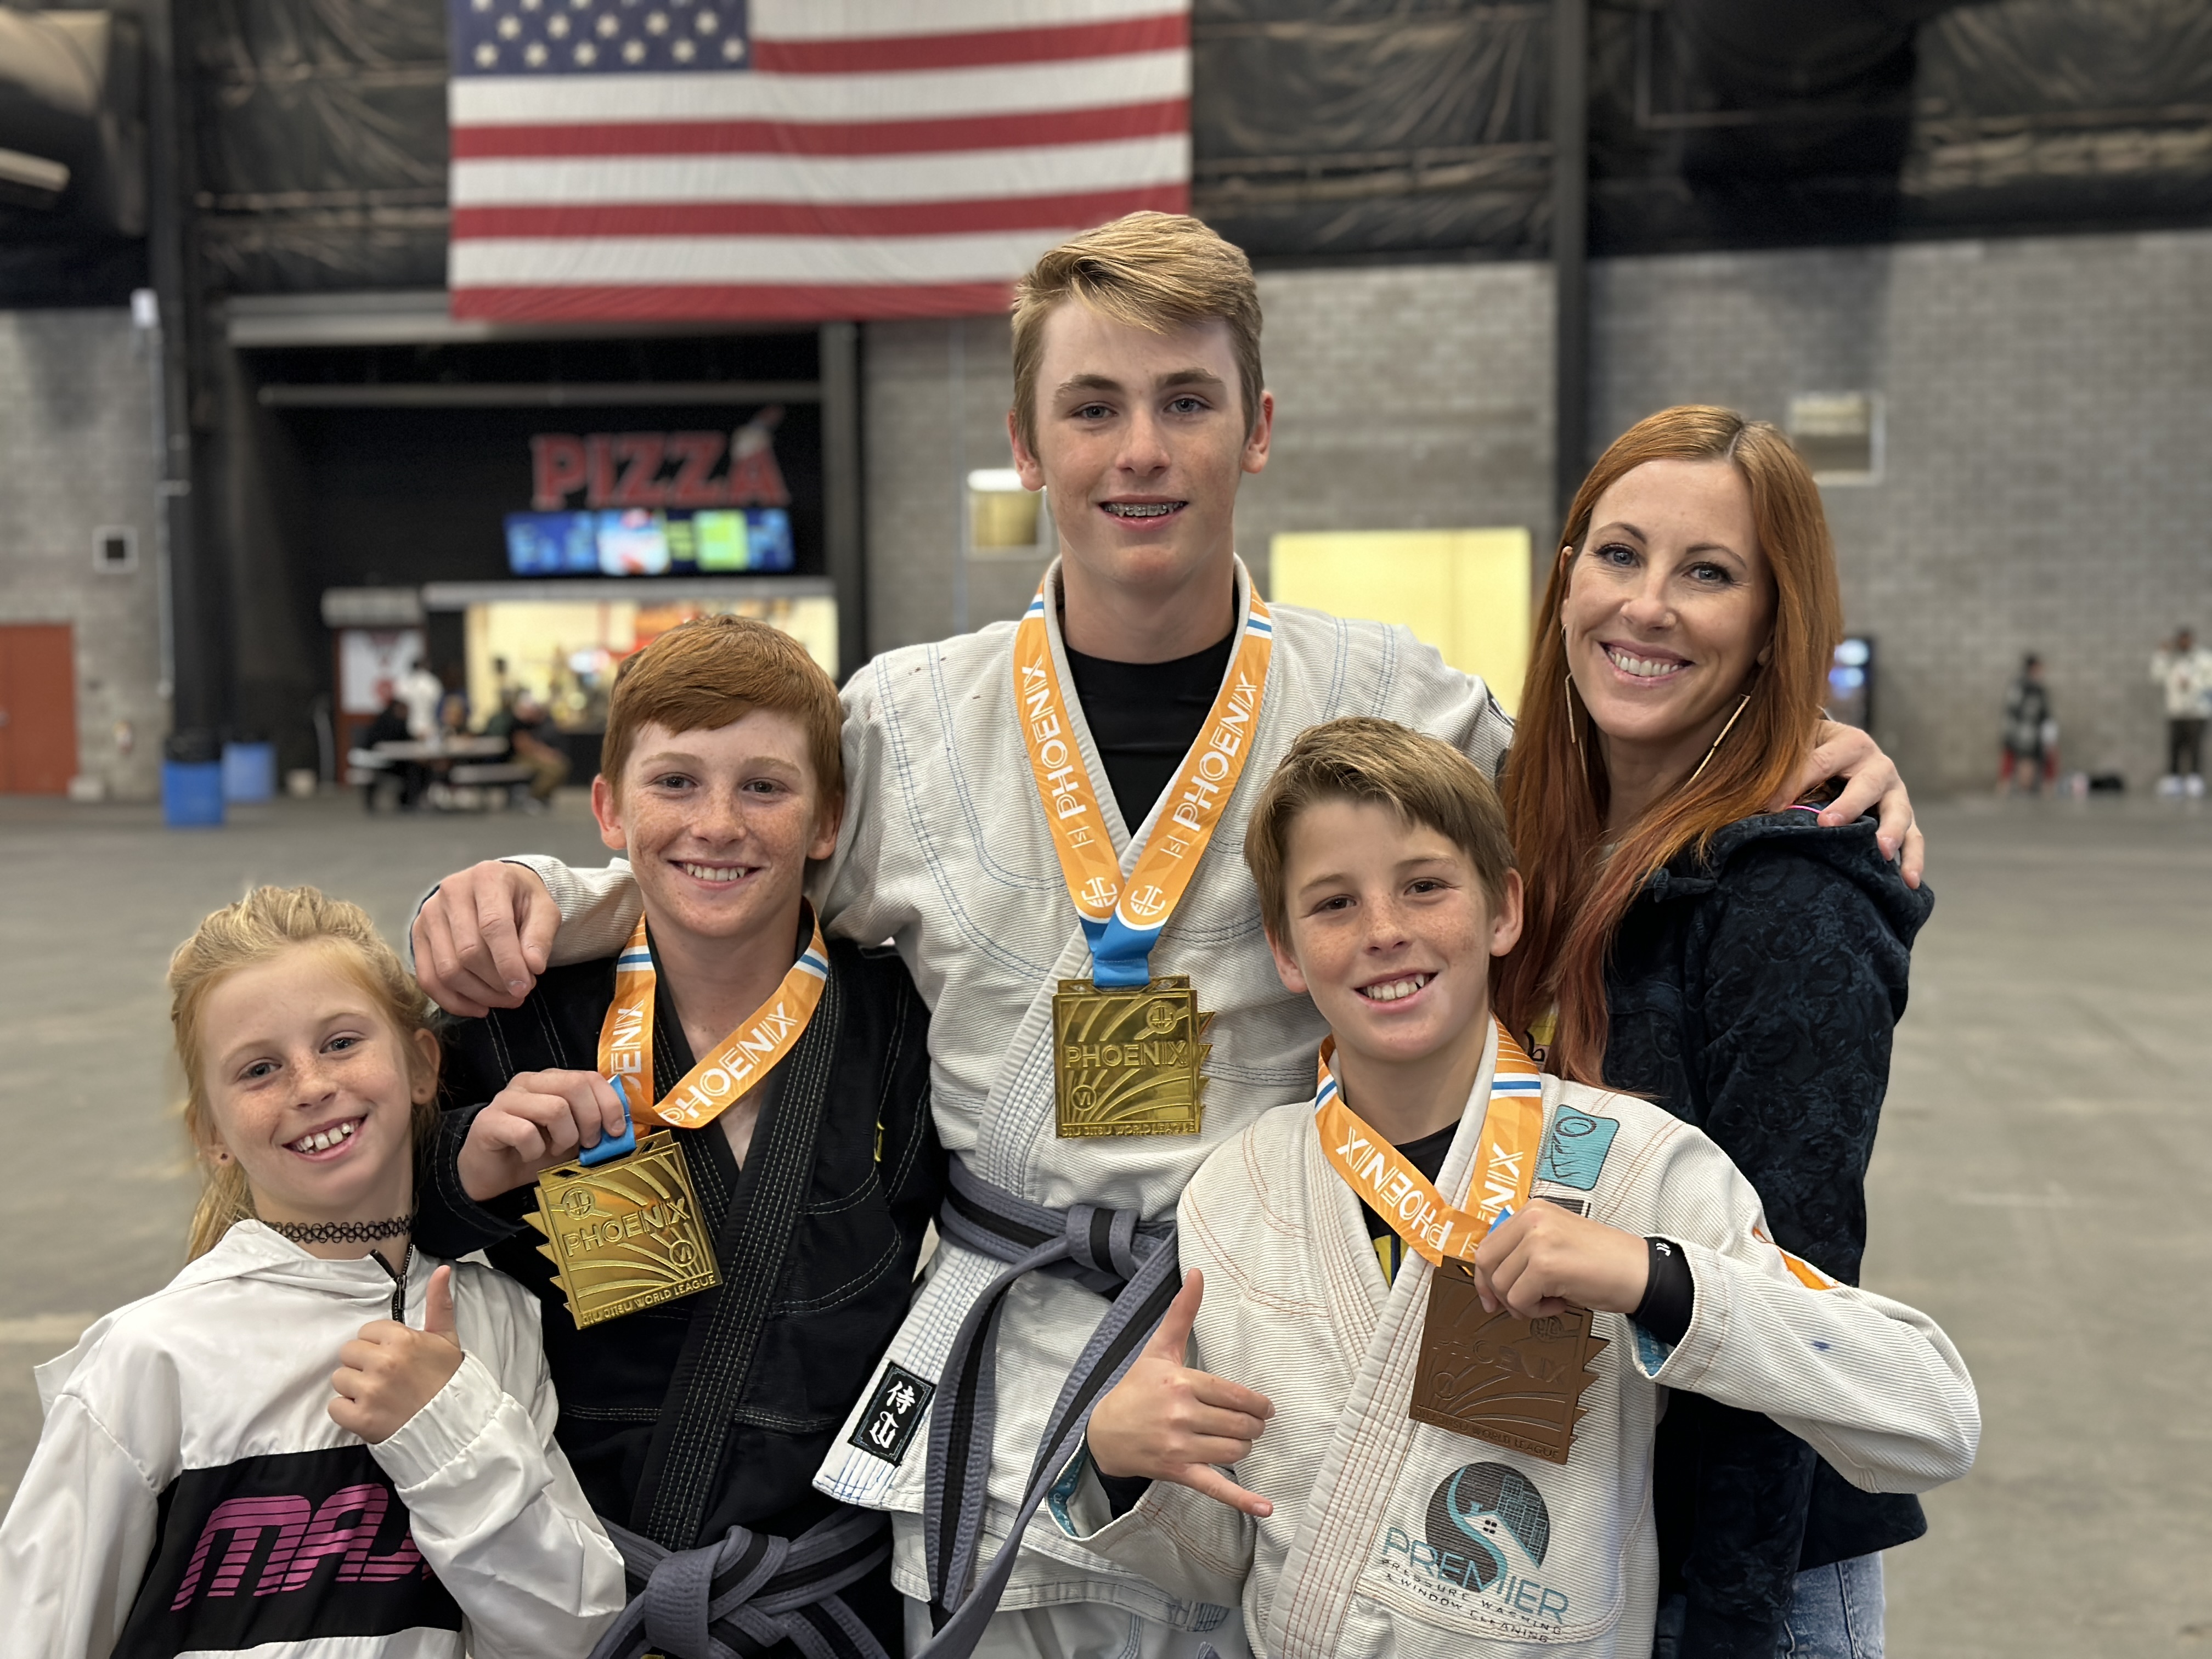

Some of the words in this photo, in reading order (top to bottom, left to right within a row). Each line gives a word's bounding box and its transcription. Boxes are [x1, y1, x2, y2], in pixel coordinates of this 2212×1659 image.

[531, 430, 791, 510] PIZZA
[1022, 654, 1086, 820] PHOENIX
[1172, 671, 1257, 831] PHOENIX
[658, 1001, 798, 1124] PHOENIX
[1064, 1040, 1189, 1068] PHOENIX
[1116, 1125, 1151, 1136] WORLD
[1154, 1123, 1195, 1134] LEAGUE
[562, 1198, 691, 1256] PHOENIX
[1336, 1126, 1454, 1252] PHOENIX
[603, 1302, 631, 1318] JITSU
[634, 1289, 672, 1307] WORLD
[674, 1274, 716, 1296] LEAGUE
[1472, 1425, 1511, 1446] WORLD
[1514, 1438, 1559, 1459] LEAGUE
[1381, 1527, 1569, 1624] PREMIER
[1381, 1559, 1470, 1601] PRESSURE
[1481, 1600, 1561, 1635] WASHING
[1400, 1578, 1463, 1610] WINDOW
[1470, 1610, 1549, 1644] CLEANING
